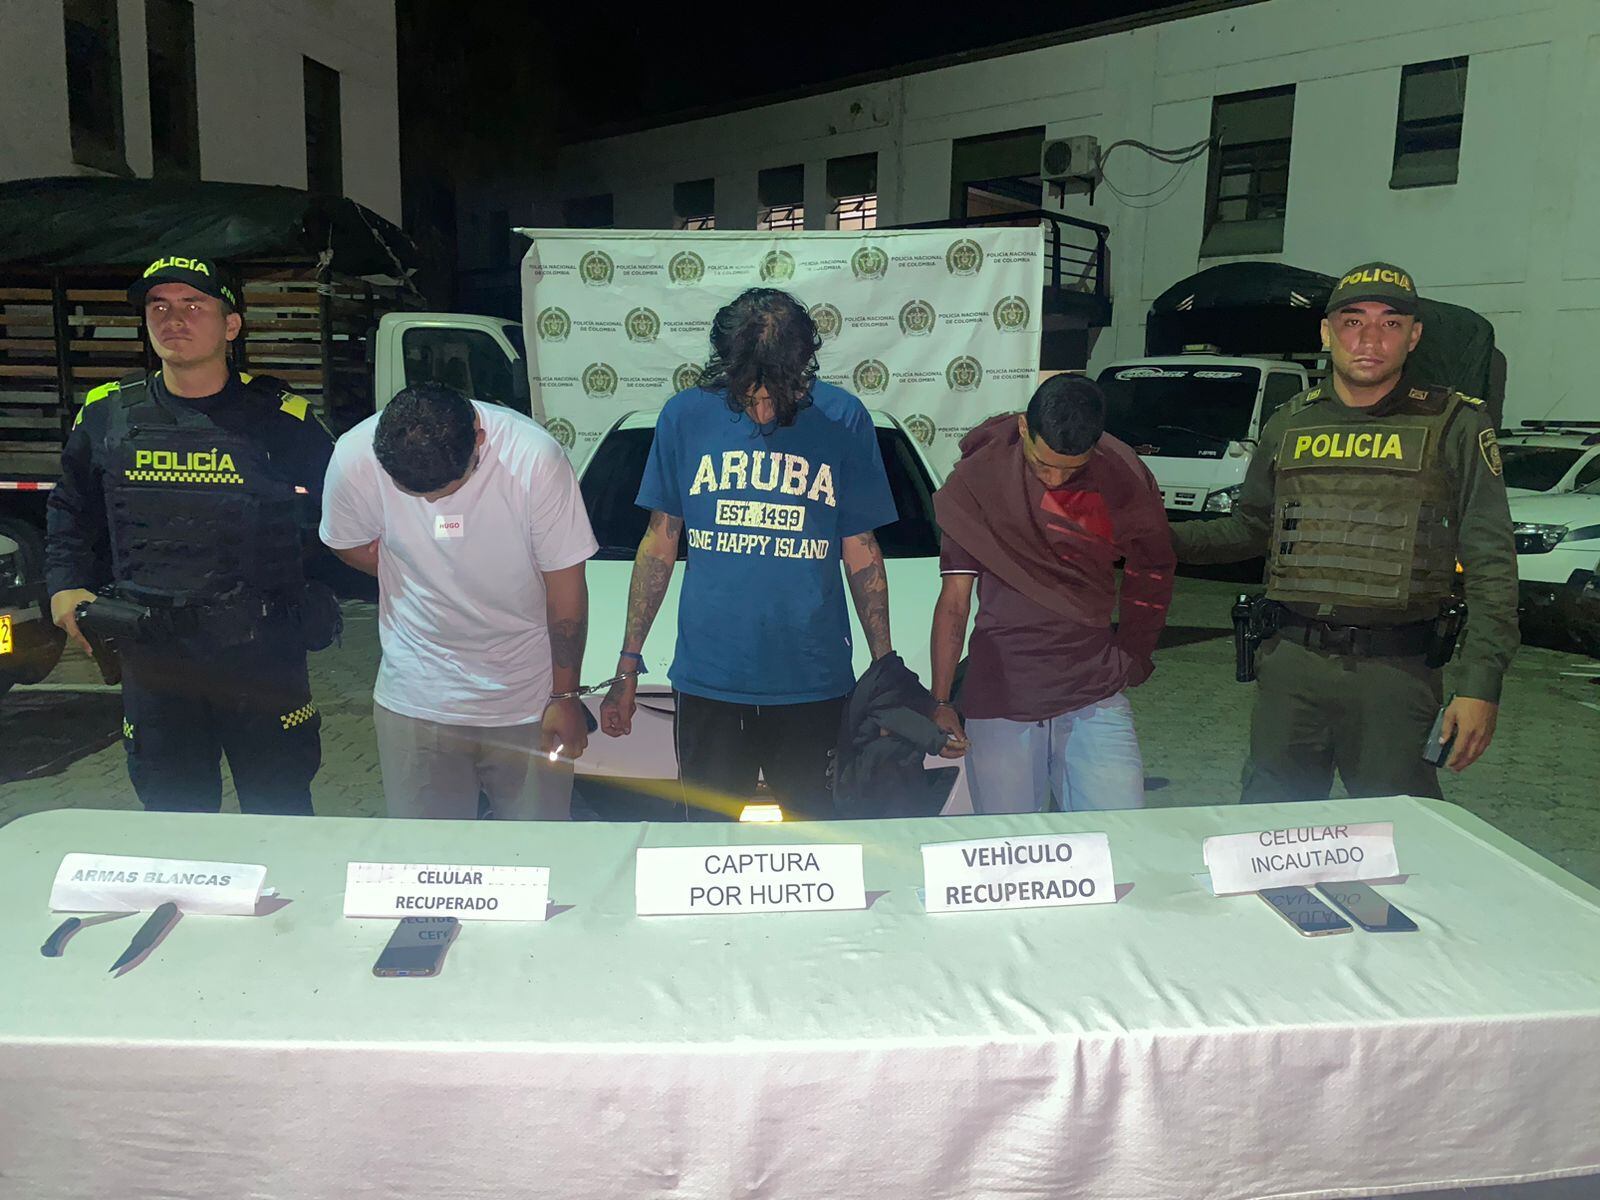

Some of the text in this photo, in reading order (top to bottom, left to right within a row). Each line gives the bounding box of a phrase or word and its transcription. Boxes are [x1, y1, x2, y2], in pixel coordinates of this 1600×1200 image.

[1294, 433, 1402, 460] POLICIA
[136, 447, 236, 472] POLICÍA
[689, 450, 837, 508] ARUBA
[719, 504, 801, 527] EST. 1499
[688, 528, 829, 560] ONE HAPPY ISLAND
[1259, 825, 1349, 847] CELULAR
[704, 852, 820, 875] CAPTURA
[1251, 846, 1365, 873] INCAUTADO
[71, 868, 232, 887] ARMAS BLANCAS
[417, 870, 483, 885] CELULAR
[395, 895, 499, 911] RECUPERADO
[690, 883, 834, 907] POR HURTO
[946, 878, 1096, 905] RECUPERADO
